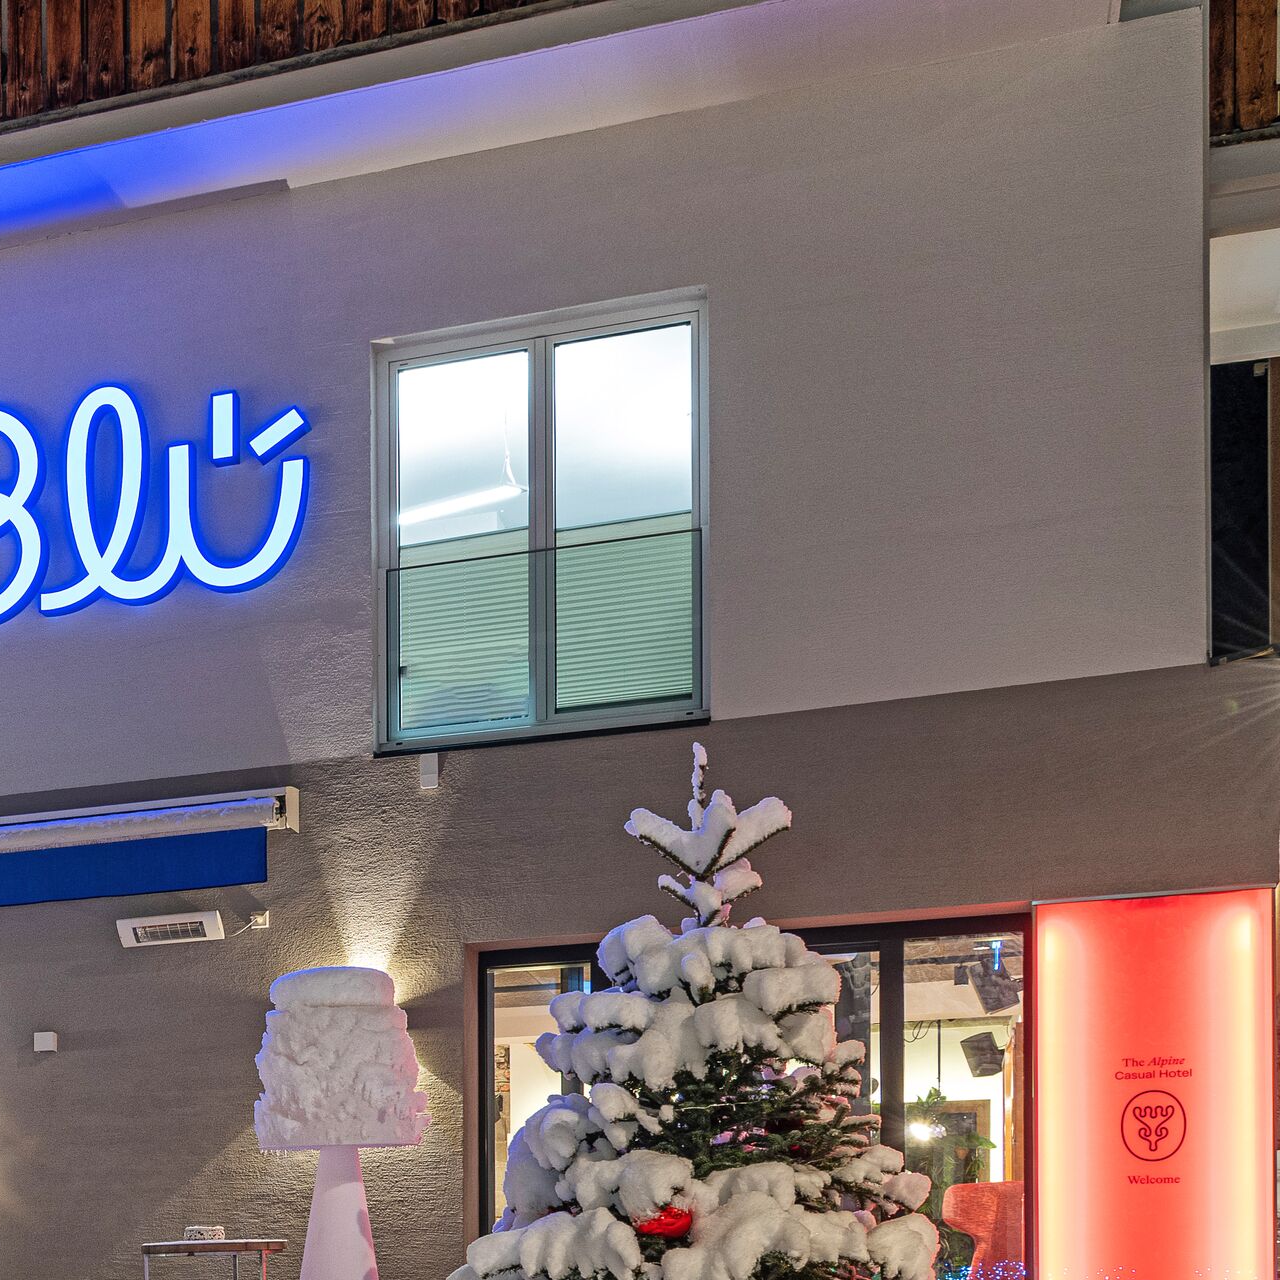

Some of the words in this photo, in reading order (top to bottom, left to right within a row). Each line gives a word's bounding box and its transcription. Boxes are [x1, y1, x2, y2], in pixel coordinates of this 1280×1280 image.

[1121, 1057, 1145, 1068] The
[1147, 1056, 1186, 1069] Alpine
[1114, 1070, 1156, 1081] Casual
[1159, 1068, 1193, 1079] Hotel
[1127, 1175, 1182, 1185] Welcome
